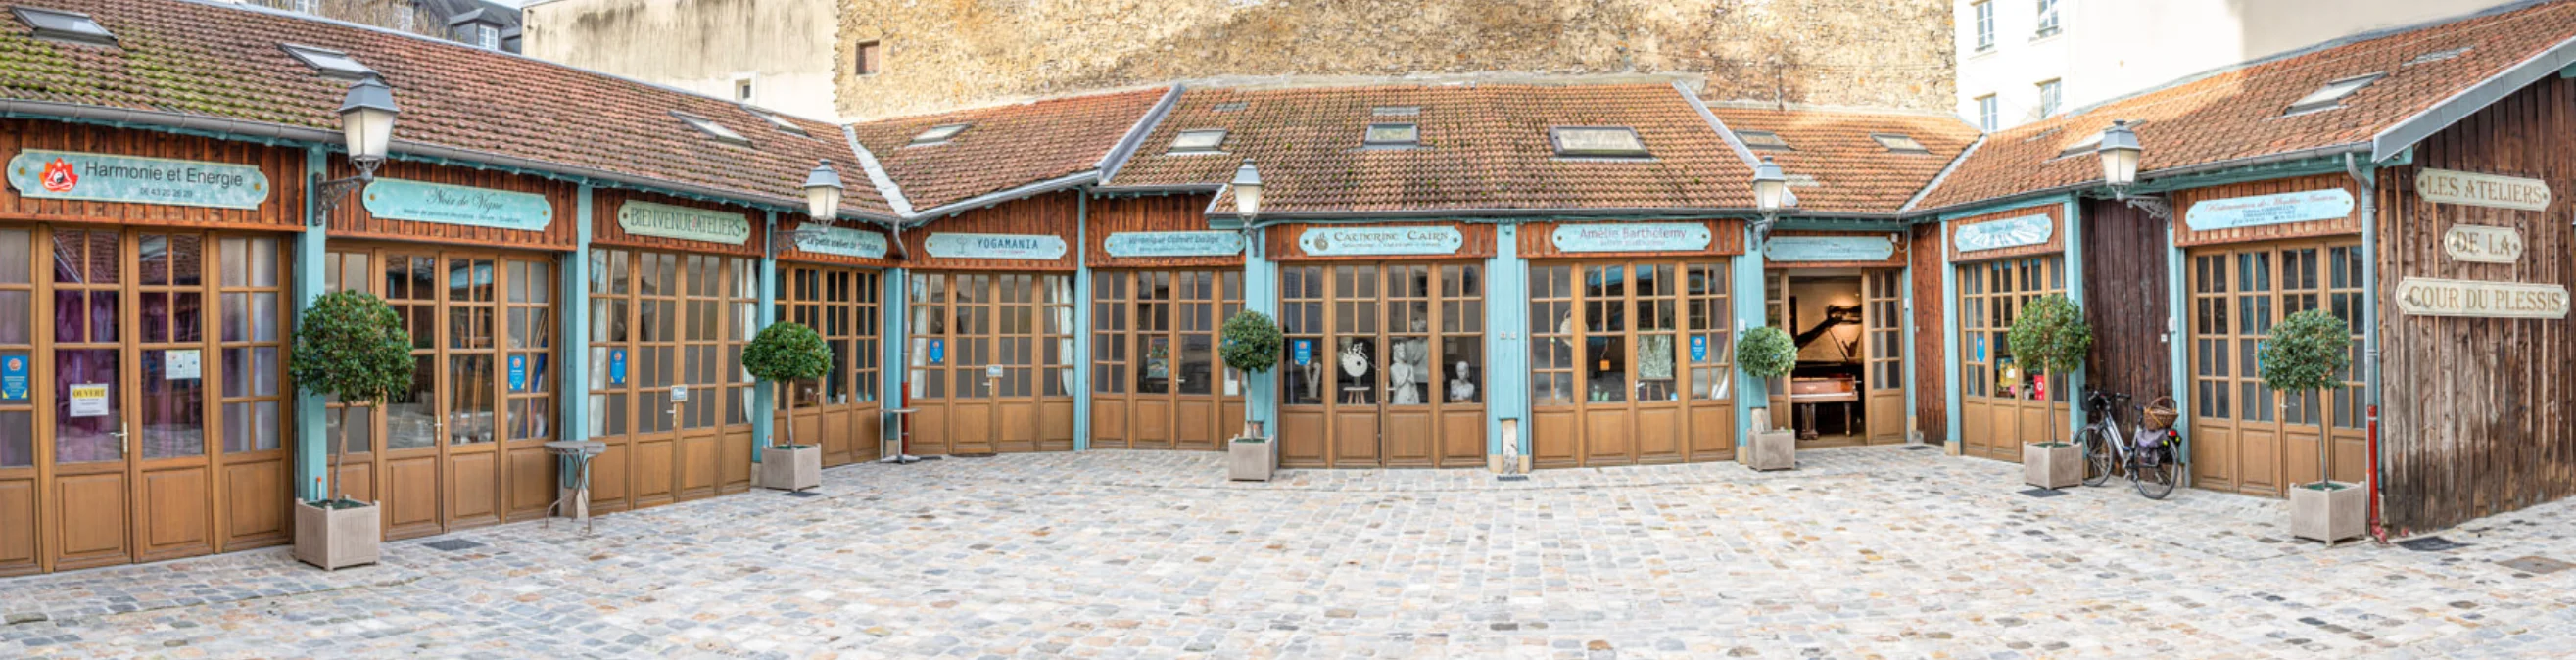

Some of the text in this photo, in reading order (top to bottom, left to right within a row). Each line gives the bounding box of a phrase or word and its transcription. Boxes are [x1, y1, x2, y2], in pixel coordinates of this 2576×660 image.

[84, 161, 243, 189] Harmonie et Energie
[426, 187, 504, 212] Noir de Vigne
[2427, 175, 2542, 204] LES ATELIERS
[630, 207, 693, 231] BIENVENUE
[694, 214, 741, 237] ATELIERS
[977, 238, 1039, 250] YOGAMANIA
[2456, 231, 2511, 255] DE LA
[2409, 286, 2561, 312] COUR DU PLESSIS
[72, 388, 105, 398] OUVERT
